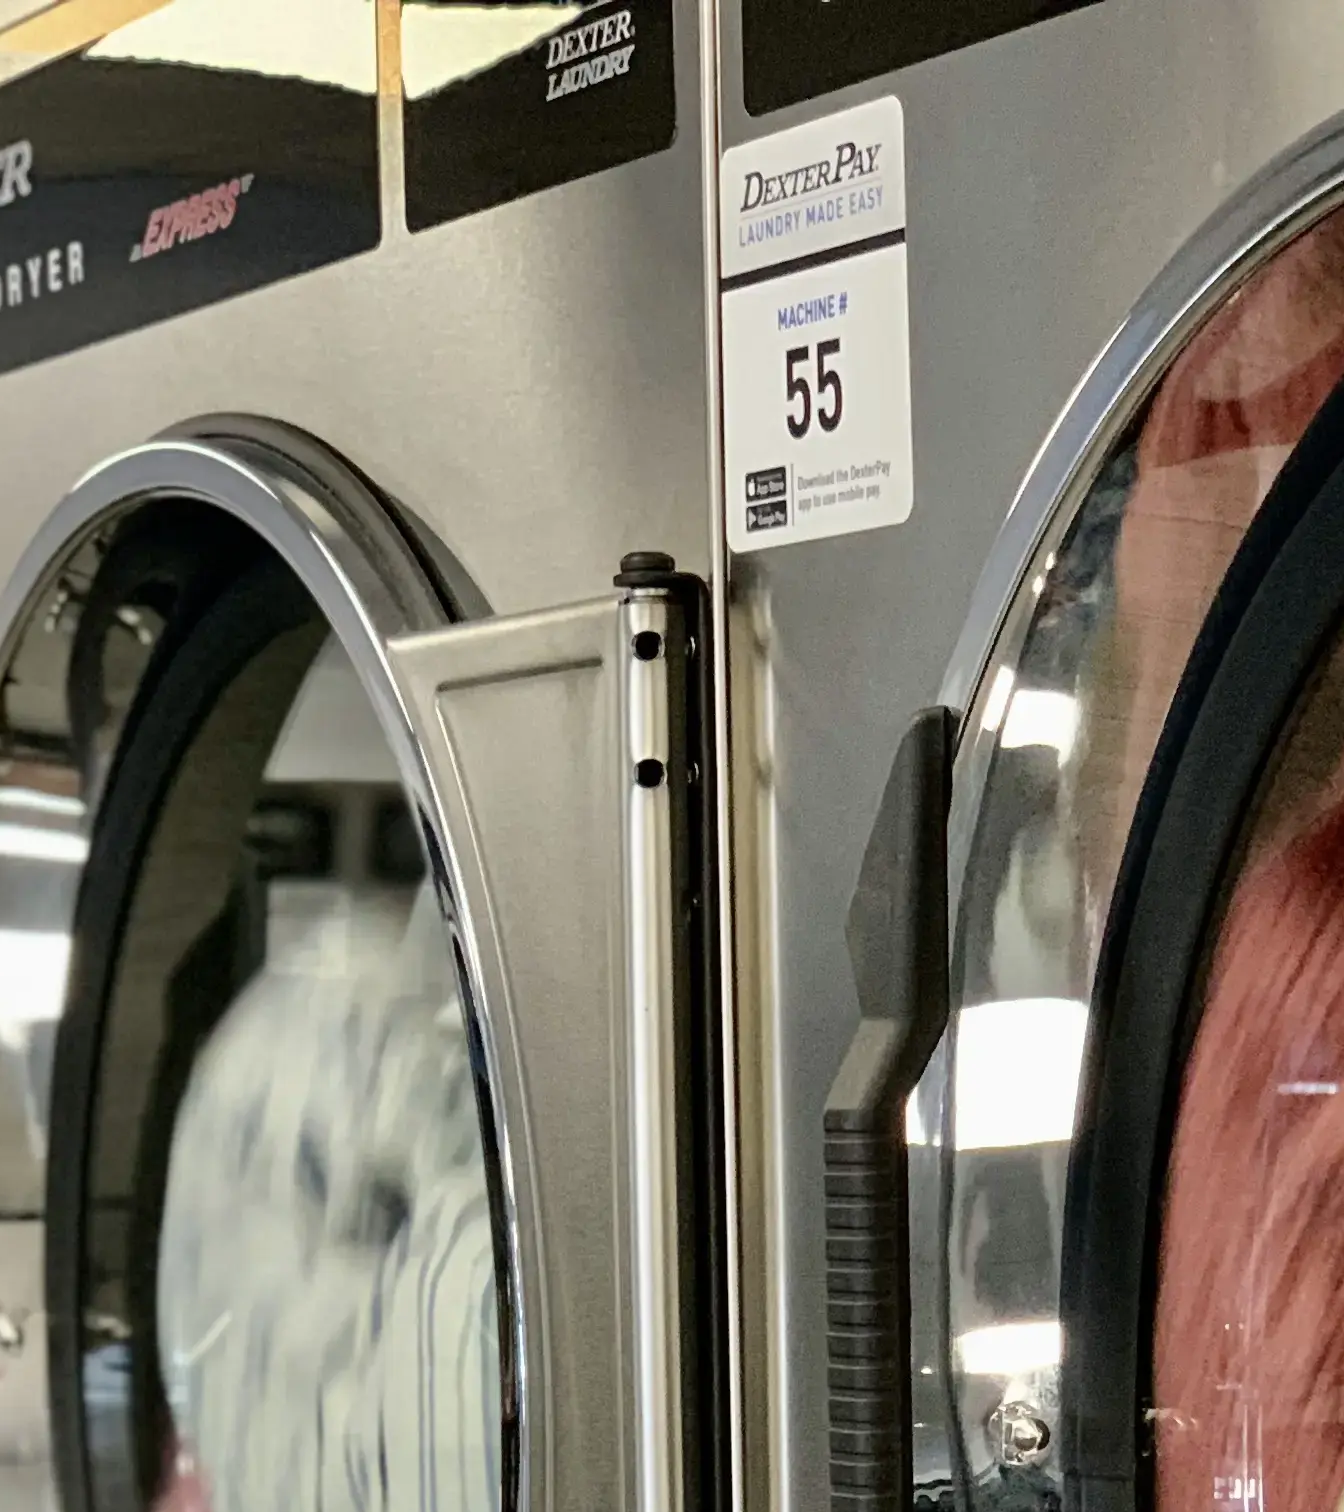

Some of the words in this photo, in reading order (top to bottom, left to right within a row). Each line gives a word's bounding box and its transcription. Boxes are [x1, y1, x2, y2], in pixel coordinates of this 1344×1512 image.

[546, 10, 632, 70] DEXTER
[546, 44, 635, 102] LAUNDRY
[141, 178, 241, 258] EXPRESS
[739, 211, 801, 248] LAUNDRY
[805, 196, 844, 229] MADE
[849, 185, 884, 216] EASY
[777, 294, 836, 331] MACHINE
[838, 291, 849, 316] #
[785, 337, 843, 440] 55
